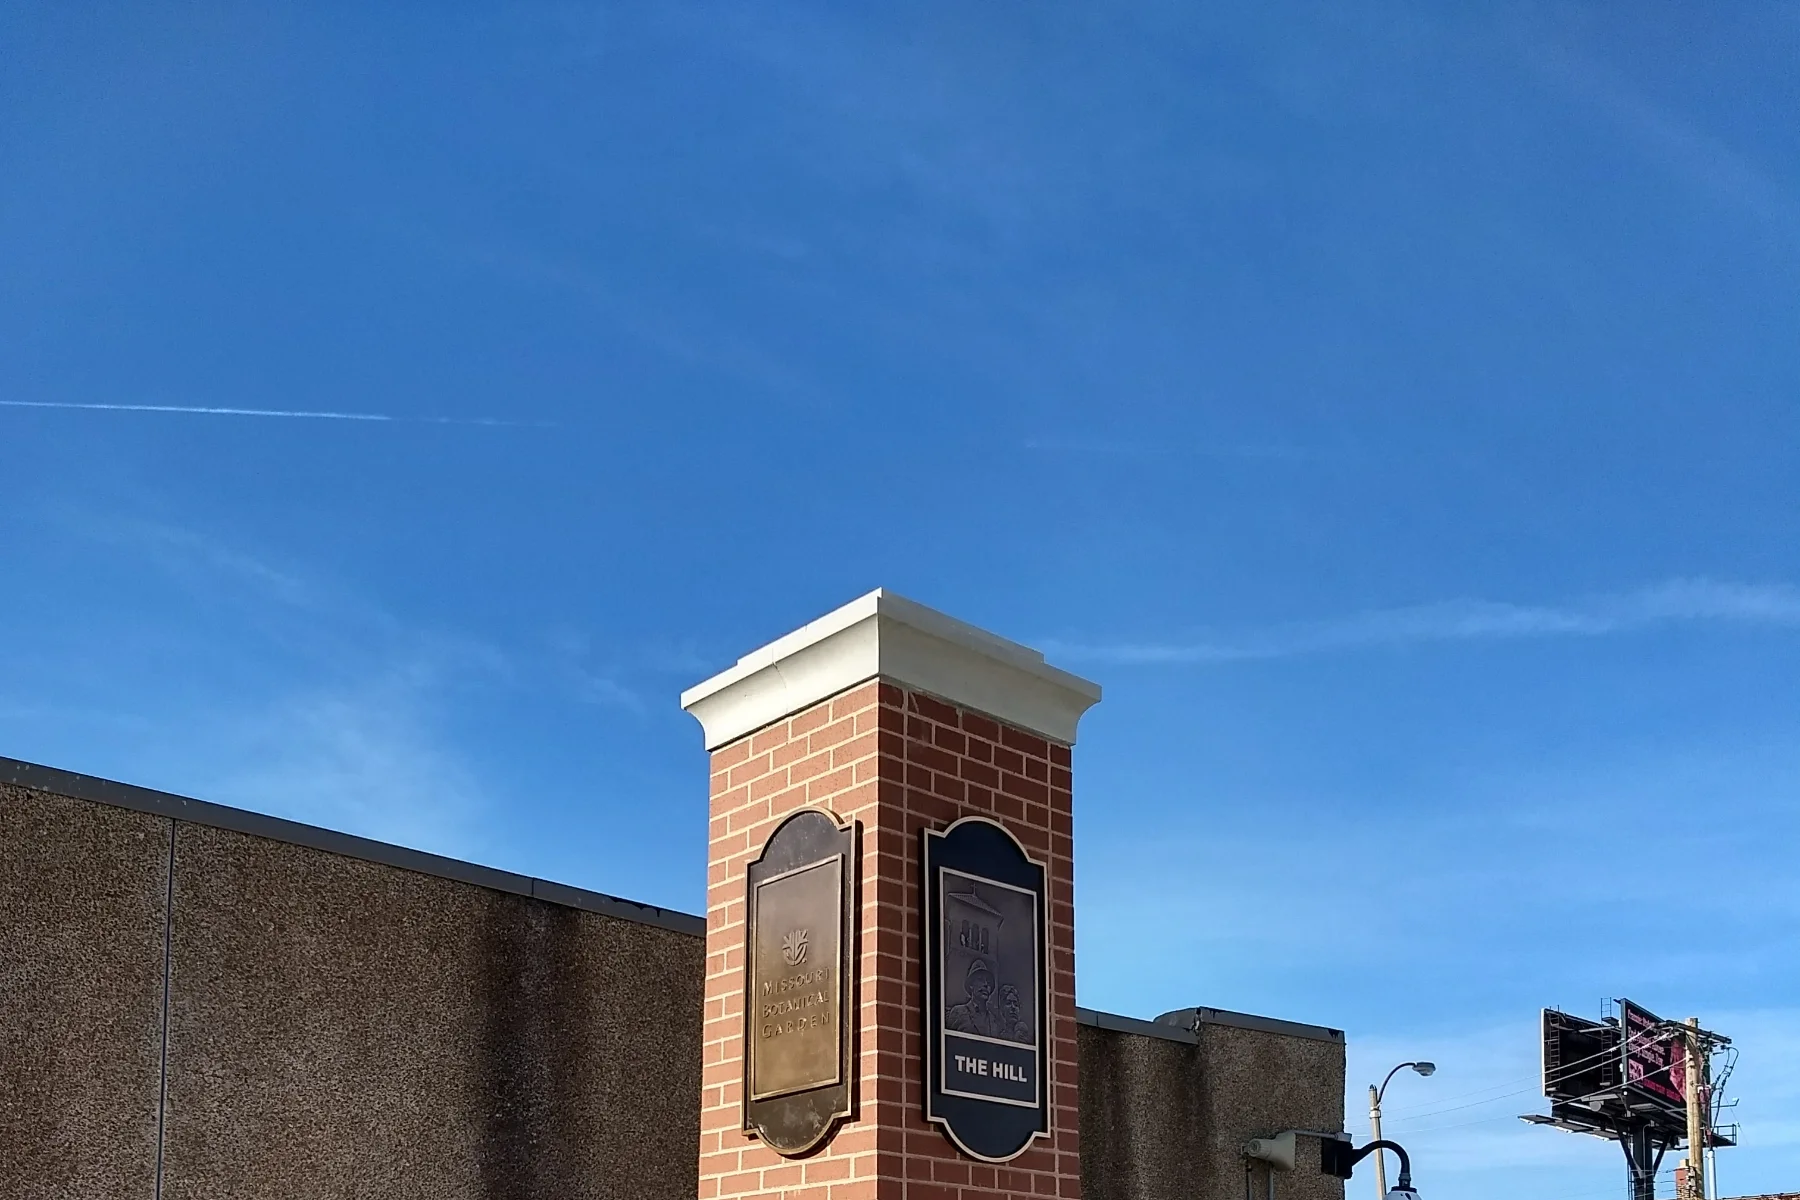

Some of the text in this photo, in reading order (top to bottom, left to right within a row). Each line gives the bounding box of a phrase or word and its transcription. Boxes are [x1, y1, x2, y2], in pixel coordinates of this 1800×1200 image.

[762, 967, 830, 997] MISSOURI
[762, 990, 830, 1019] BOTANICAL
[762, 1011, 830, 1039] GARDEN
[954, 1054, 1028, 1083] THE HILL
